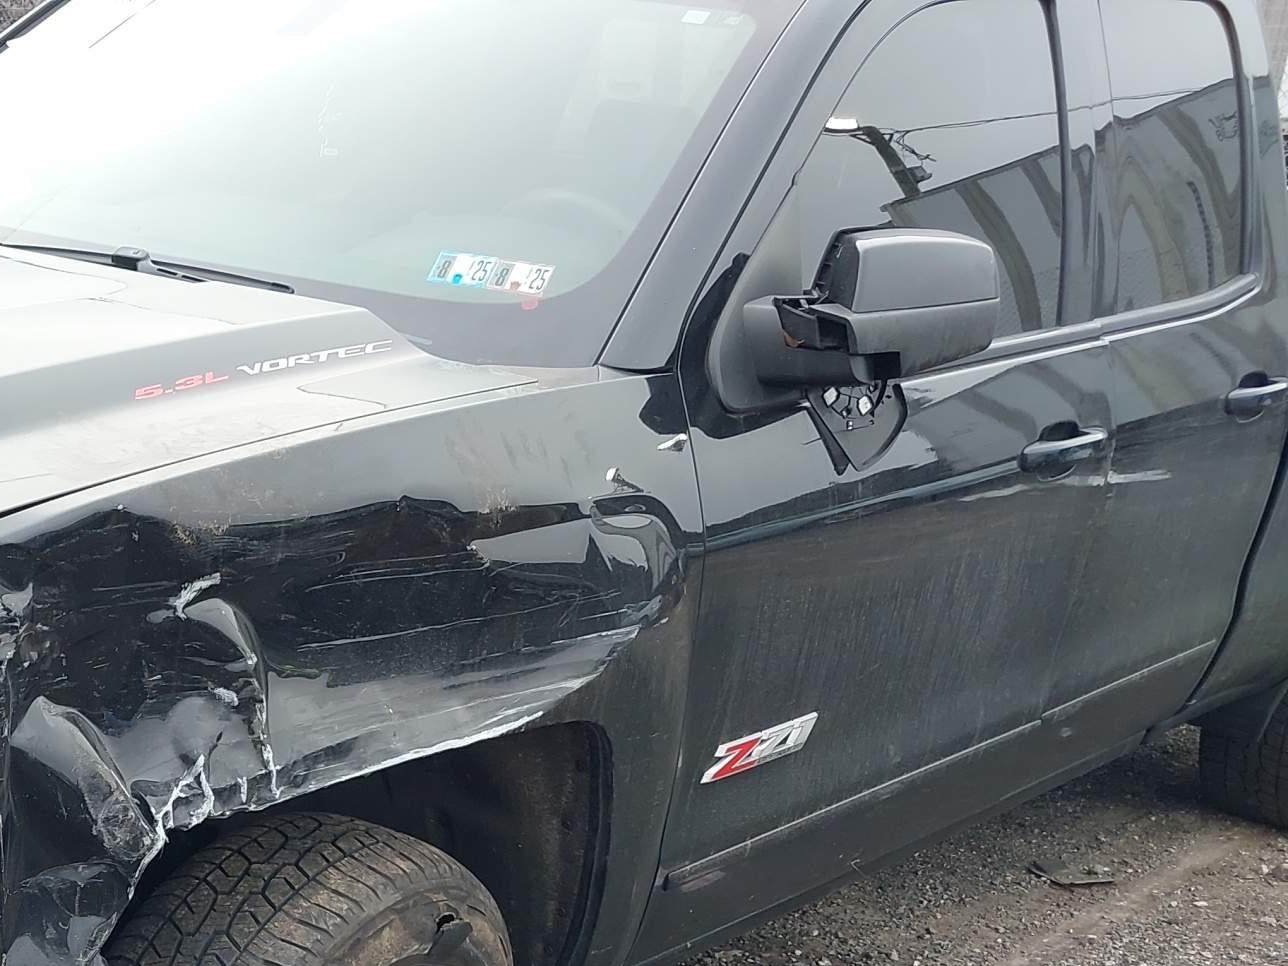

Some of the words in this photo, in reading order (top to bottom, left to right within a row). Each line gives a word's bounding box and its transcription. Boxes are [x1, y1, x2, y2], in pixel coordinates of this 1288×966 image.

[471, 259, 492, 282] 25
[528, 267, 550, 291] 25
[134, 371, 230, 401] 5.3L
[236, 339, 394, 376] VORTEC
[700, 711, 819, 785] Z71
